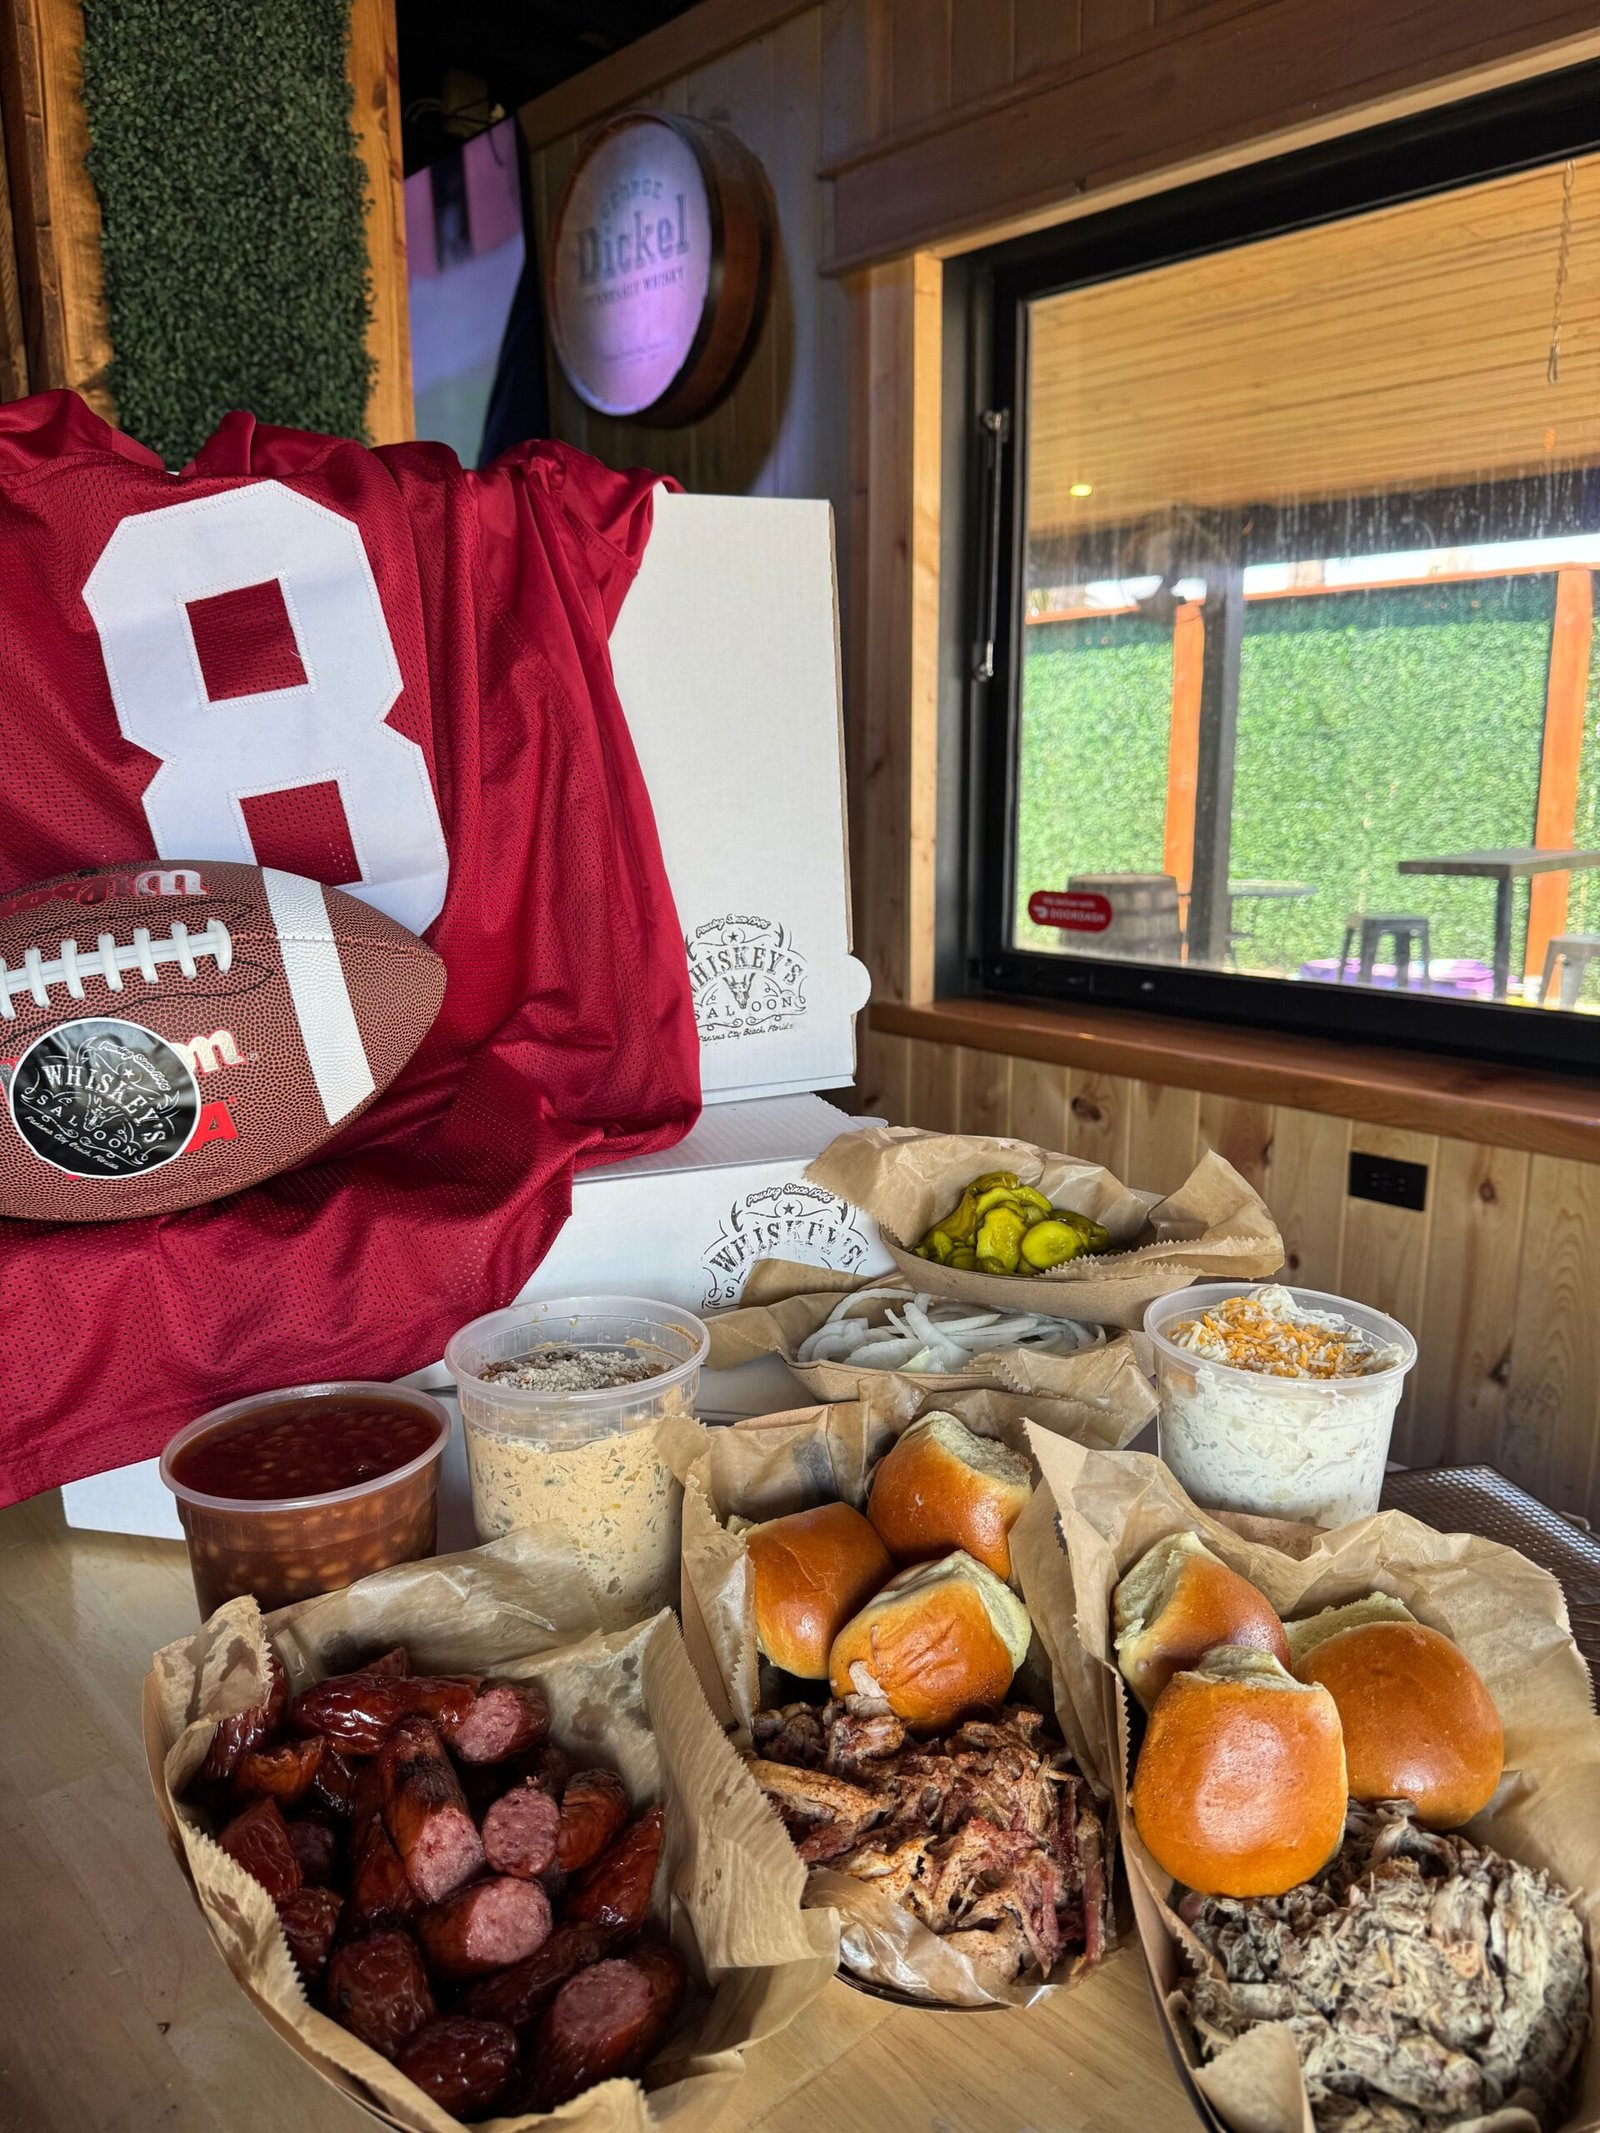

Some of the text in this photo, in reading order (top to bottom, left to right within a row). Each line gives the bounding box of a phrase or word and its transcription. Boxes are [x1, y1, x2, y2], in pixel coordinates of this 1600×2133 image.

[578, 193, 690, 287] Dickel
[82, 479, 449, 932] 8
[690, 945, 804, 993] HISKEY'S
[37, 1094, 137, 1156] SALOON
[42, 1062, 166, 1143] WHISKEY'S
[783, 1182, 810, 1196] Since
[808, 1187, 835, 1204] 1946
